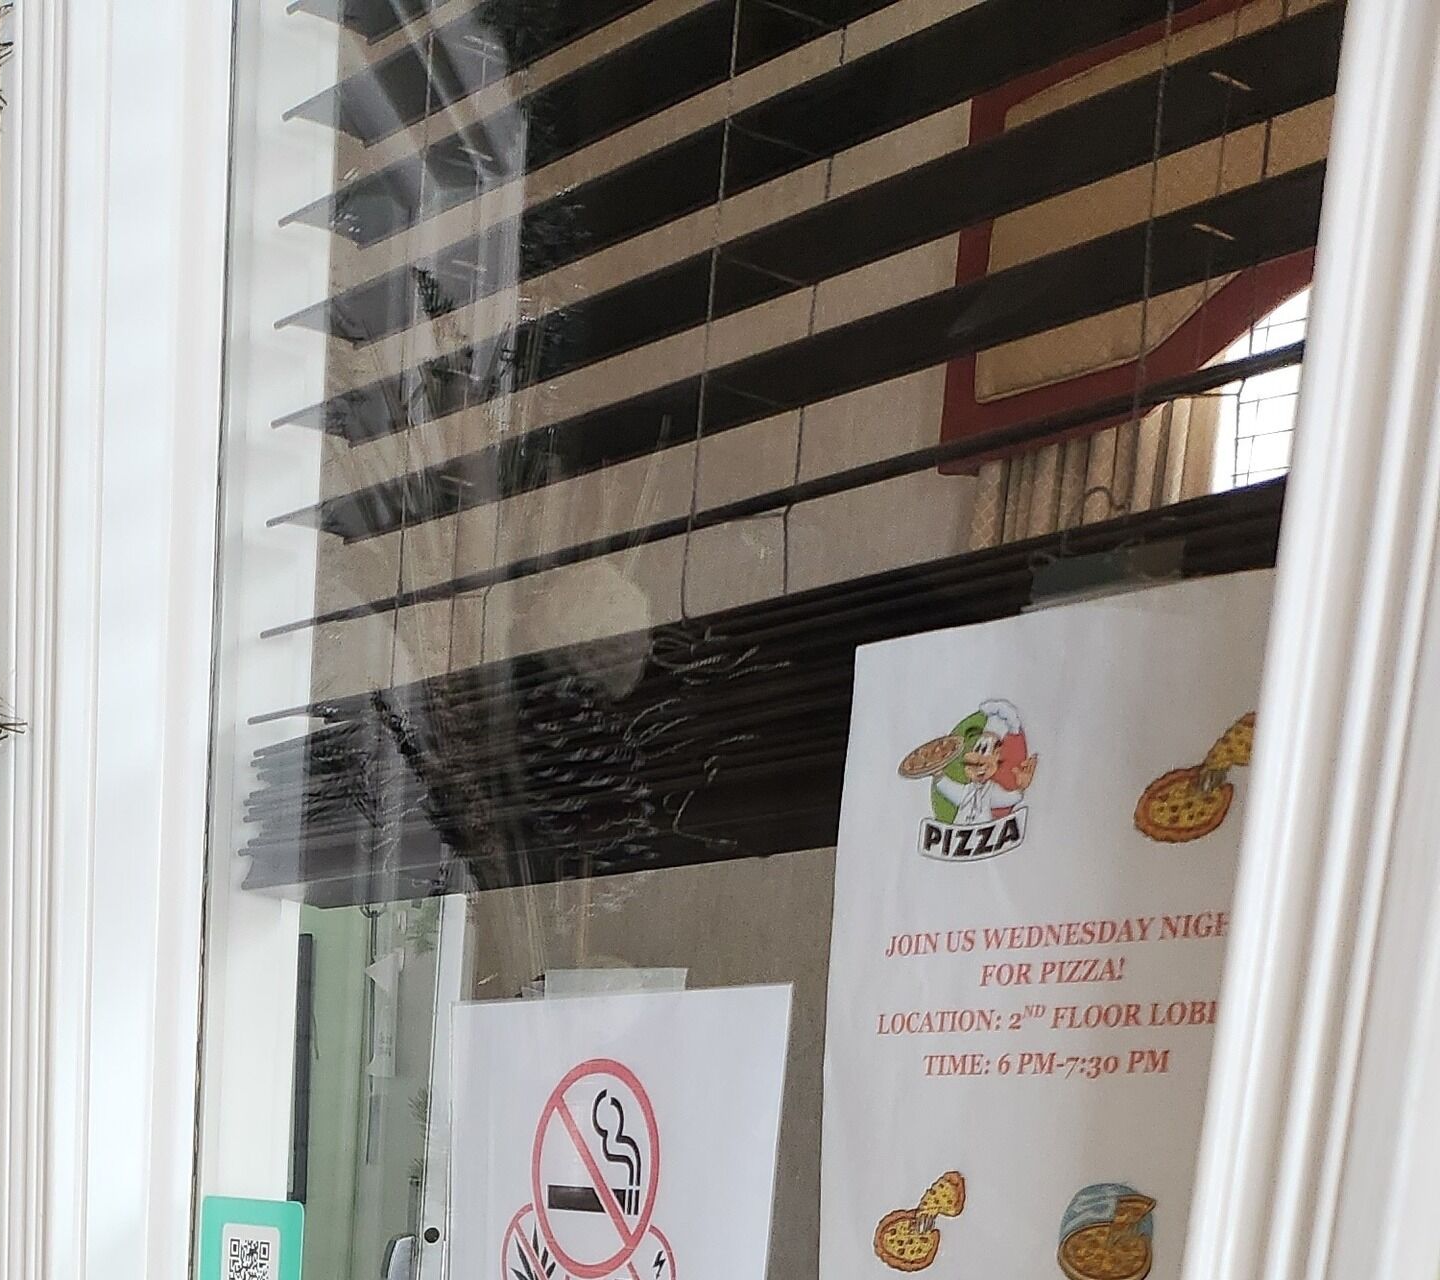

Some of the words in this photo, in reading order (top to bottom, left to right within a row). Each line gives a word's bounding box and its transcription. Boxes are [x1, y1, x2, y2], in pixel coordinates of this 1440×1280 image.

[923, 815, 1021, 858] PIZZA
[885, 932, 939, 958] JOIN
[946, 928, 975, 953] US
[983, 916, 1155, 950] WEDNESDAY
[979, 962, 1032, 987] FOR
[1038, 956, 1126, 984] PIZZA!
[876, 1009, 1002, 1035] LOCATION:
[1008, 1003, 1047, 1030] 2ND
[1050, 1003, 1141, 1029] FLOOR
[923, 1053, 991, 1077] TIME:
[997, 1052, 1011, 1076] 6
[1016, 1052, 1119, 1081] PM-7:30
[1126, 1049, 1171, 1074] PM
